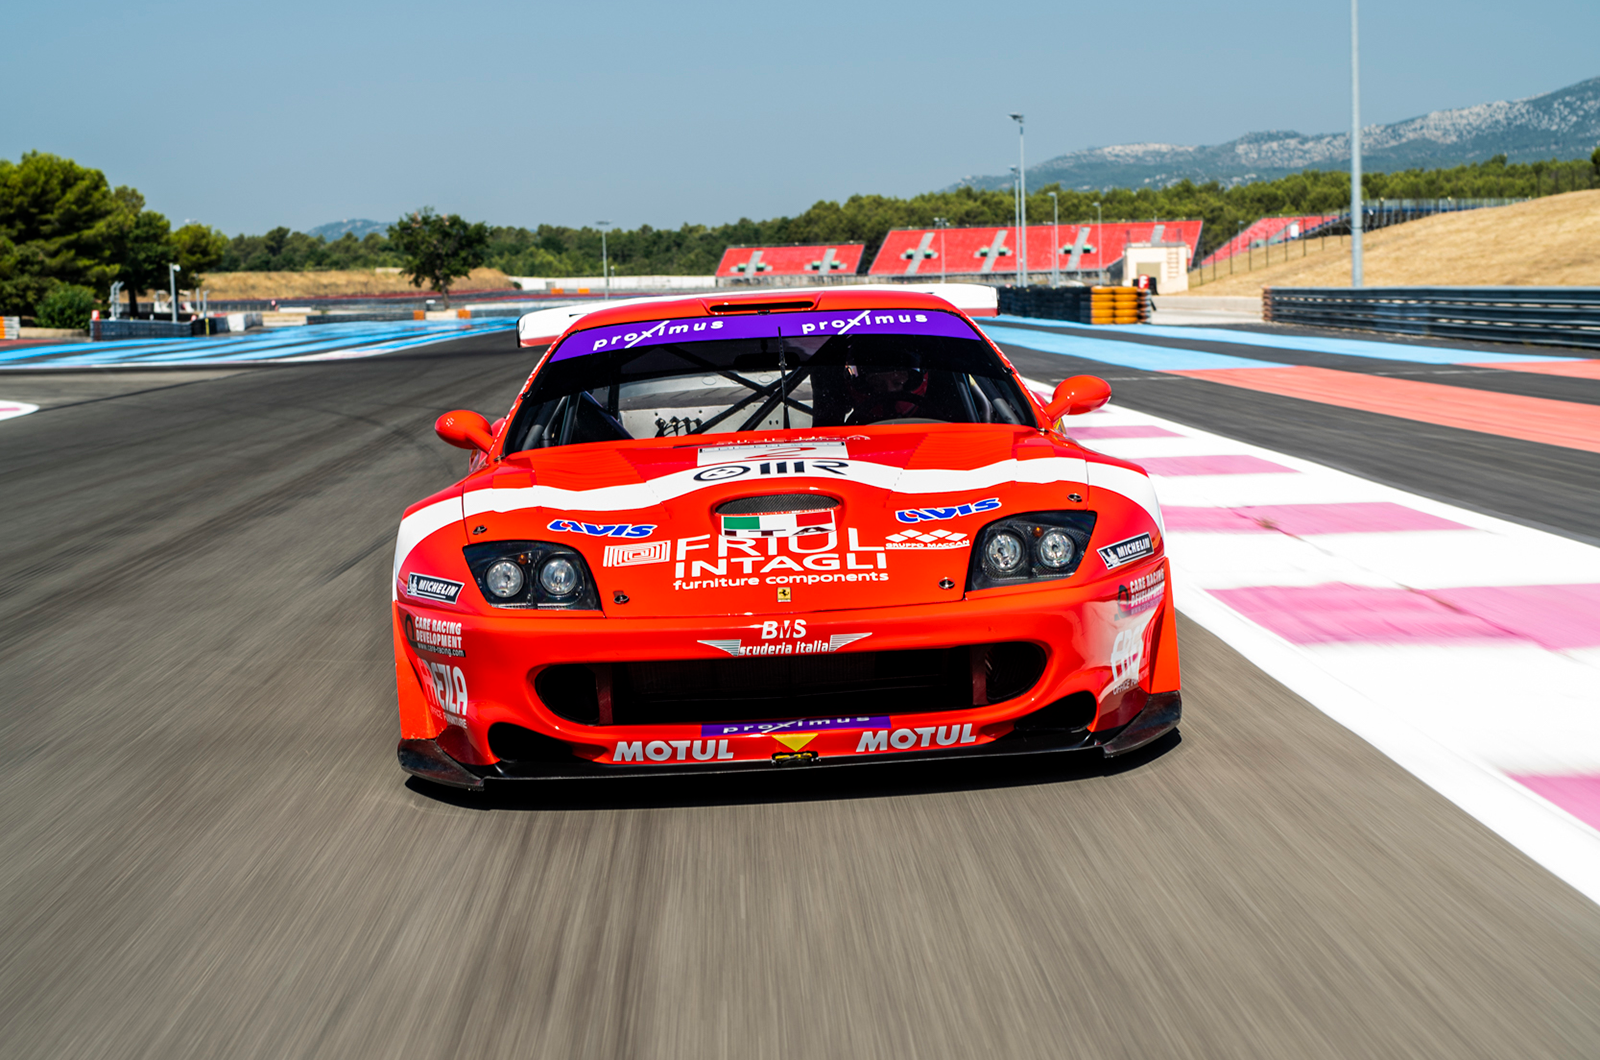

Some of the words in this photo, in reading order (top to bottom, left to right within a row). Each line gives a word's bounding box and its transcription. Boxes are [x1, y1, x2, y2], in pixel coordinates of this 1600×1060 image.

[801, 310, 928, 335] proximus
[592, 320, 724, 351] proximus
[676, 527, 884, 561] FRIUL
[1116, 537, 1151, 558] MICHELIN
[675, 552, 888, 579] INTAGLI
[417, 579, 459, 597] MICHELIN
[673, 577, 760, 591] furniture
[765, 571, 889, 585] components
[415, 616, 431, 630] CARE
[432, 619, 462, 636] RACING
[761, 619, 807, 640] BMS
[416, 629, 462, 649] DEVELOPMENT
[738, 642, 793, 656] scuderia
[795, 639, 829, 654] italia
[722, 716, 871, 735] proximus
[856, 723, 977, 752] MOTUL
[613, 739, 734, 762] MOTUL
